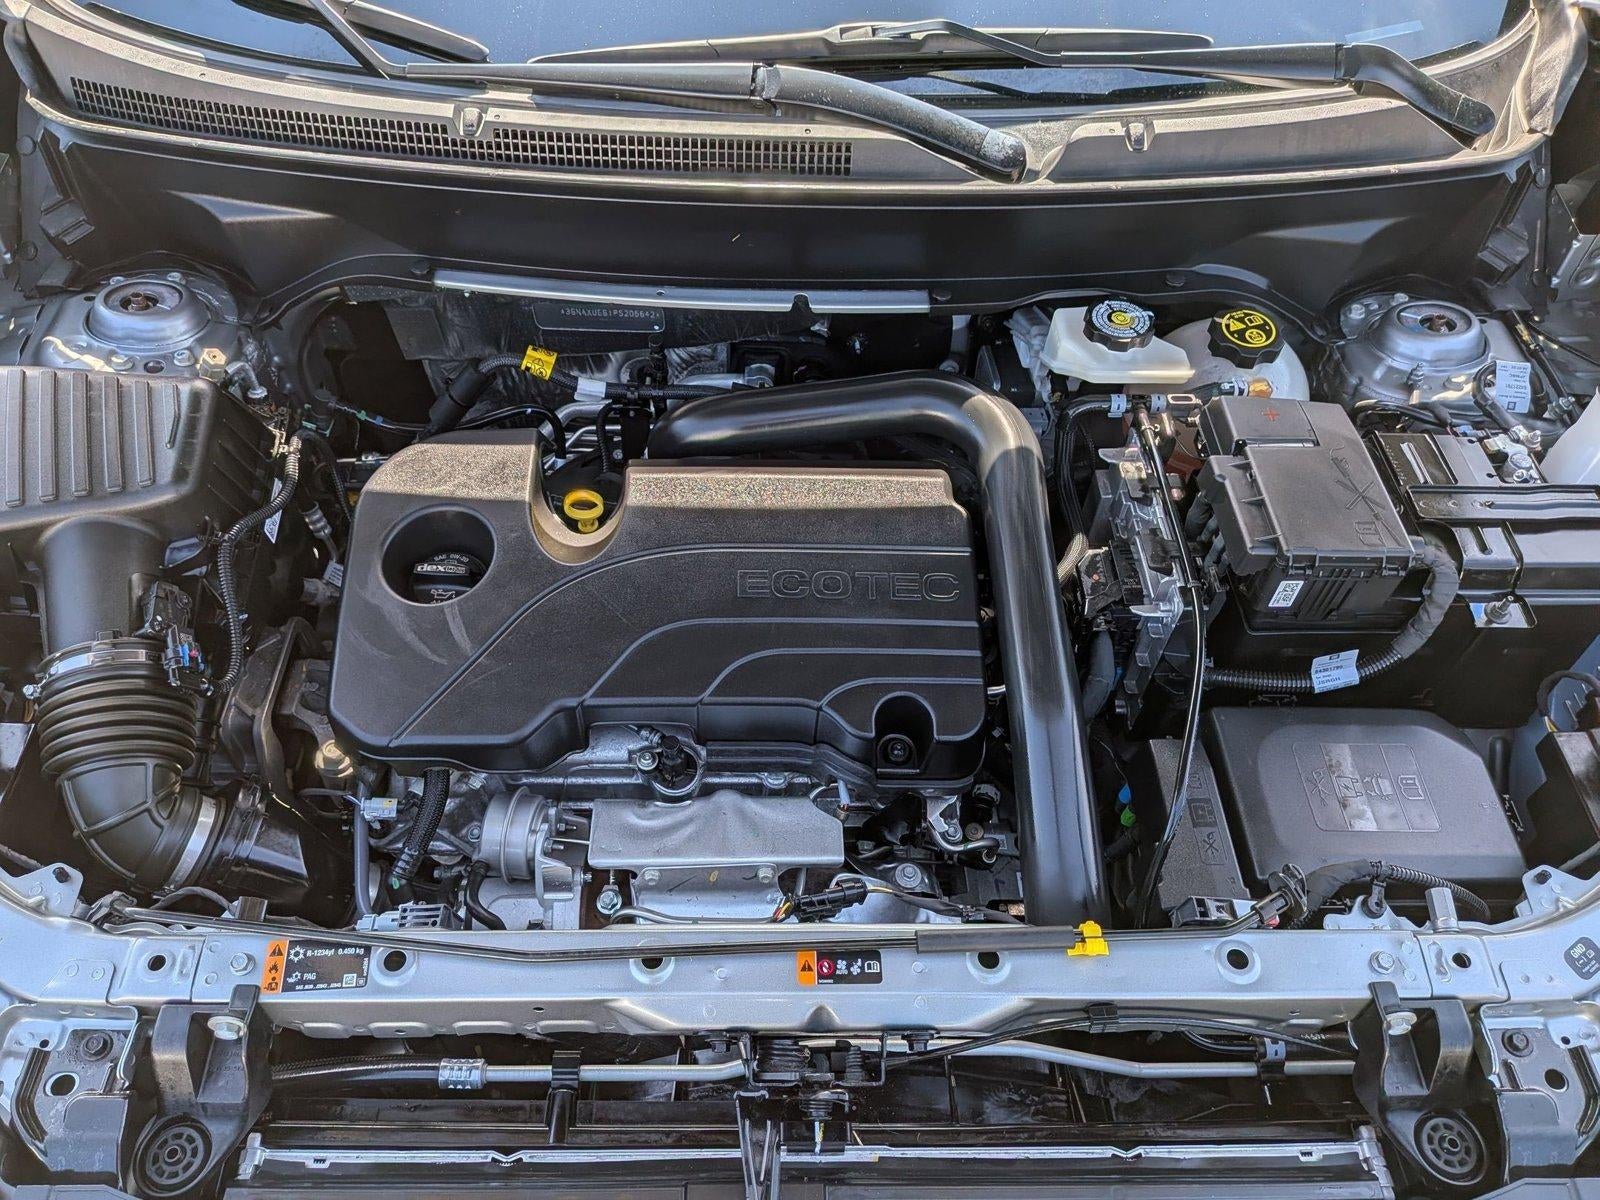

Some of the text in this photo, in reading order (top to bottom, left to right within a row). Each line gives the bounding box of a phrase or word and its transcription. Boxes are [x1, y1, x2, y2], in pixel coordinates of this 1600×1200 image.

[737, 569, 960, 601] ECOTEC
[306, 948, 335, 957] R-1234yf
[355, 947, 365, 956] kg
[1570, 943, 1585, 958] GND
[303, 972, 317, 980] PAG
